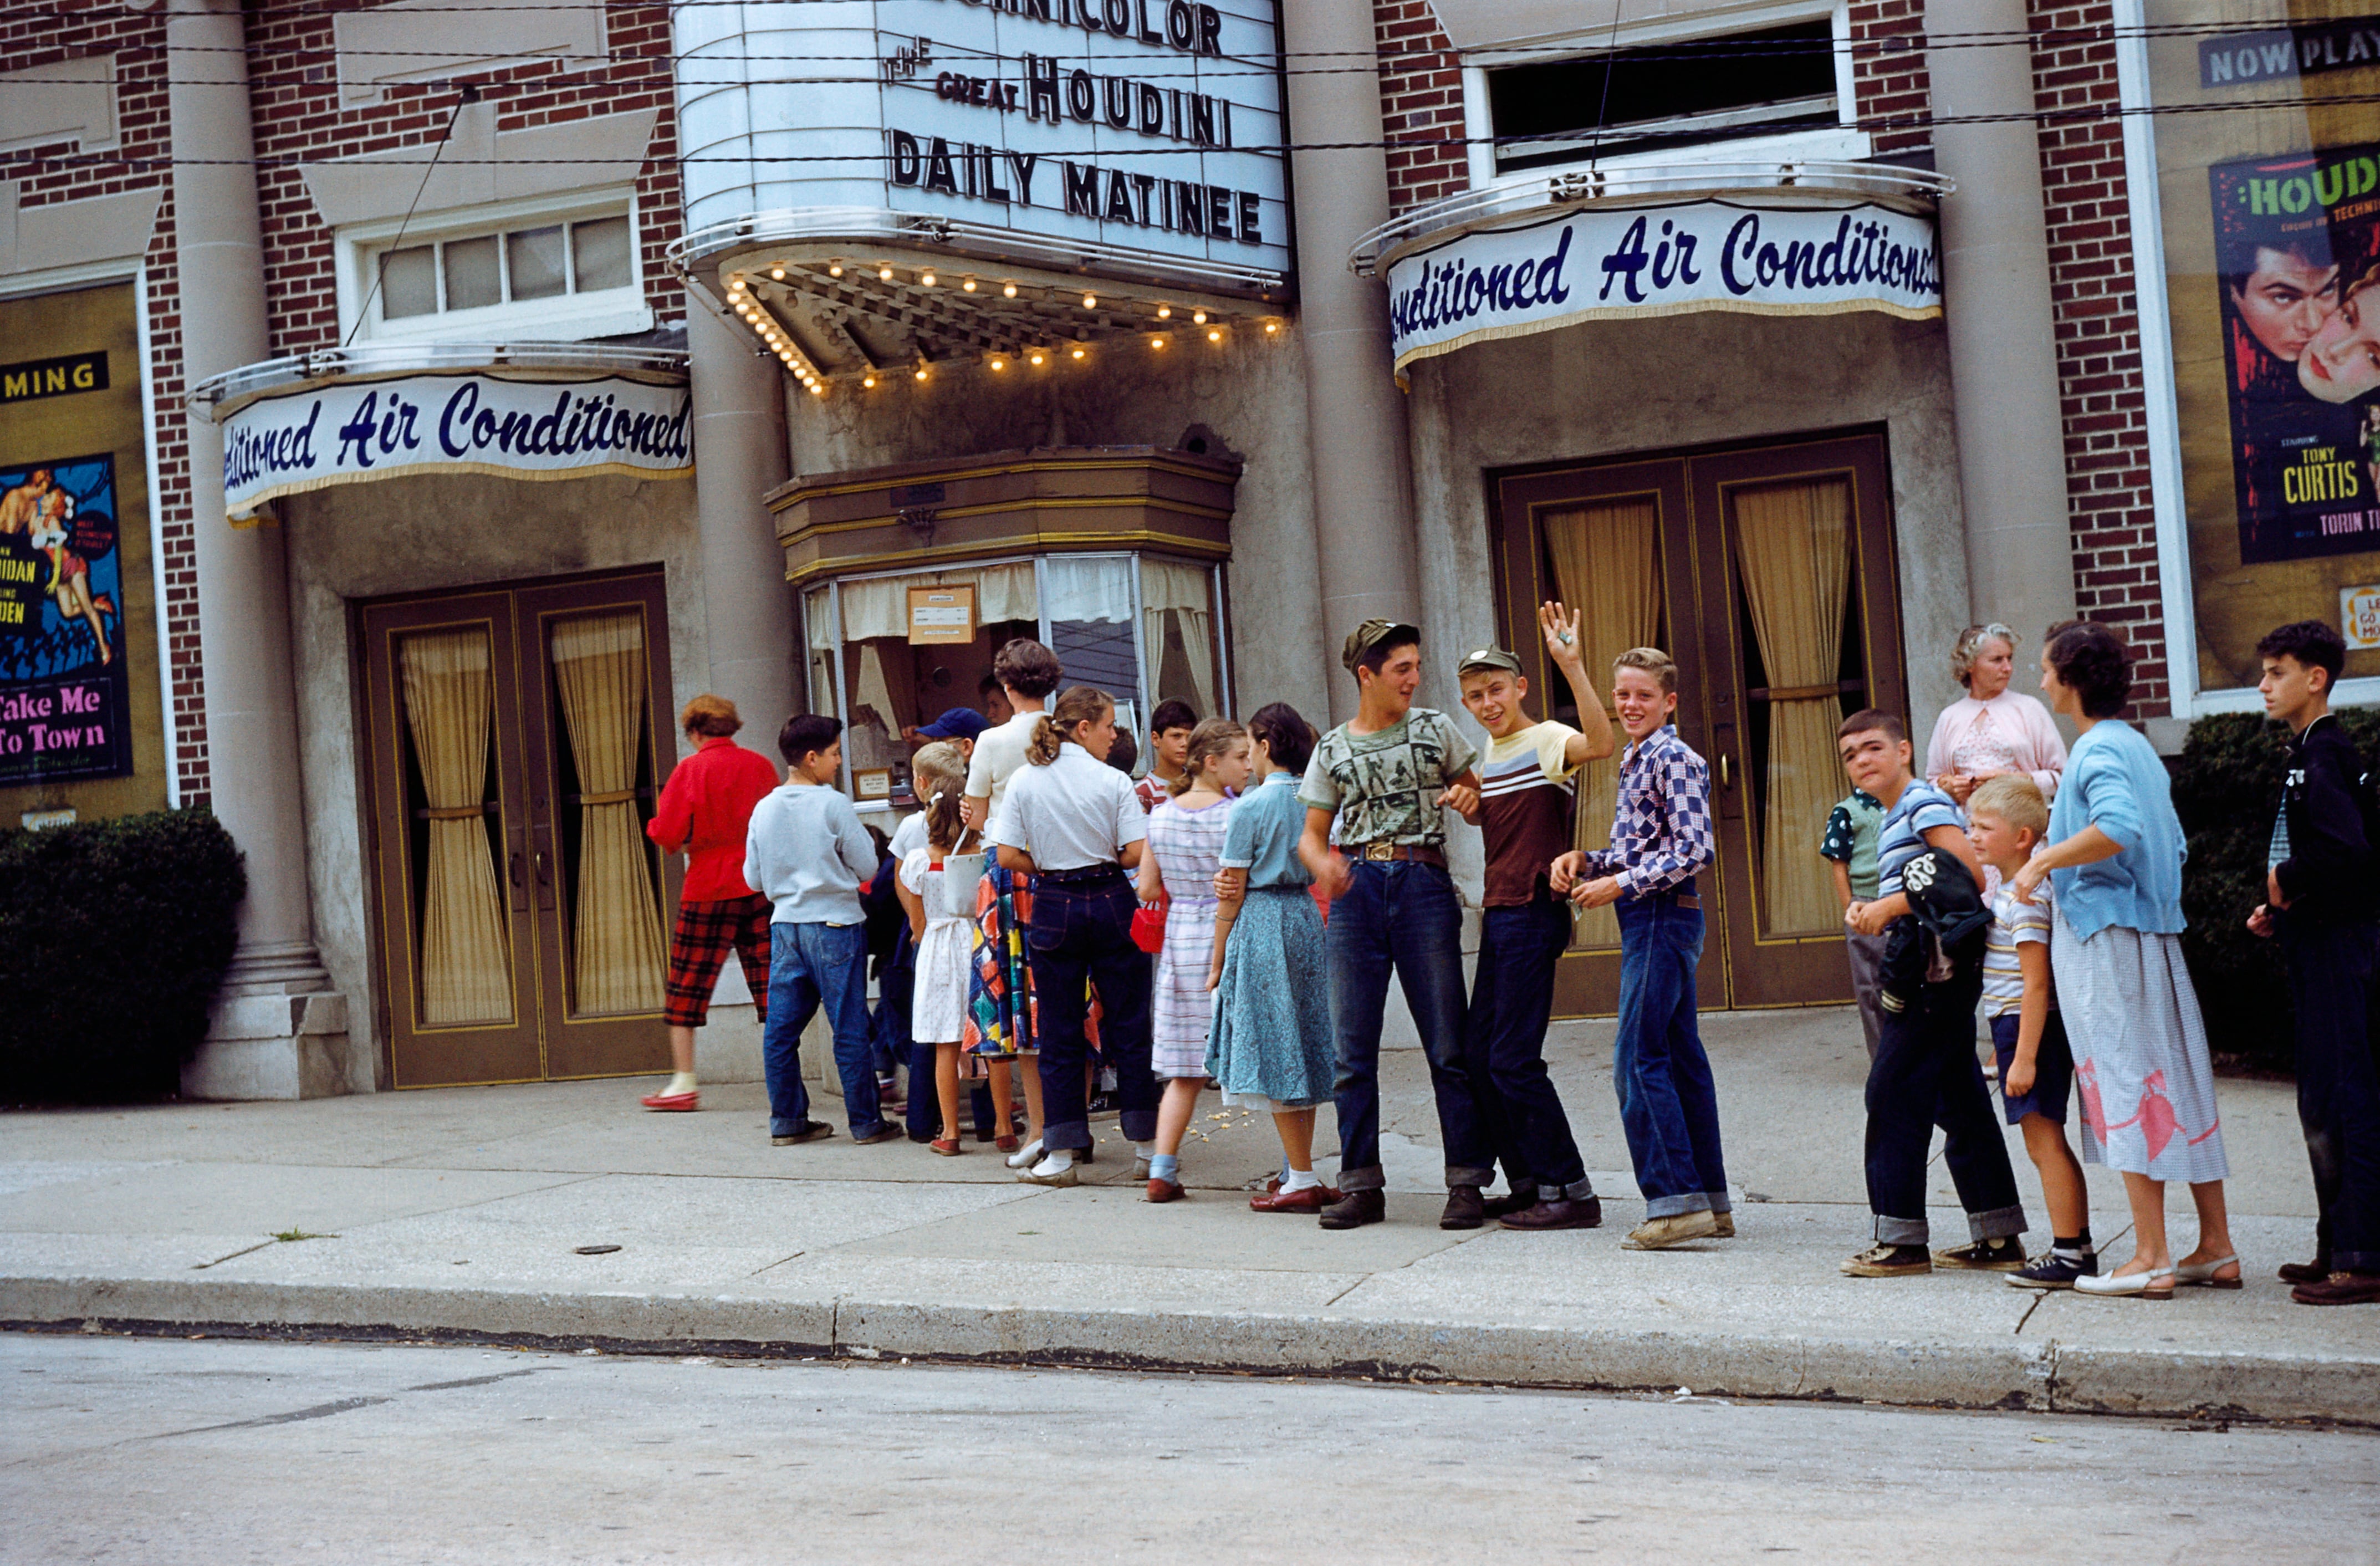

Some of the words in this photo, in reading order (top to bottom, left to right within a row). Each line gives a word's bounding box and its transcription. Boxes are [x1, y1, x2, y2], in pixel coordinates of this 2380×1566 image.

[2210, 42, 2291, 82] NOW
[882, 35, 932, 84] THE
[936, 71, 1019, 113] GREAT
[1024, 52, 1231, 147] HOUDINI
[889, 127, 1037, 207] DAILY
[1062, 160, 1262, 245] MATINEE
[1599, 215, 1702, 303] Air
[4, 363, 94, 398] MING
[337, 390, 421, 467] Air
[438, 381, 692, 459] Conditioned
[2301, 446, 2336, 465] TONY
[2284, 460, 2359, 504] CURTIS
[2320, 511, 2364, 537] TORIN
[0, 559, 36, 584] IDAN
[59, 686, 101, 715] Me
[28, 723, 105, 752] Town
